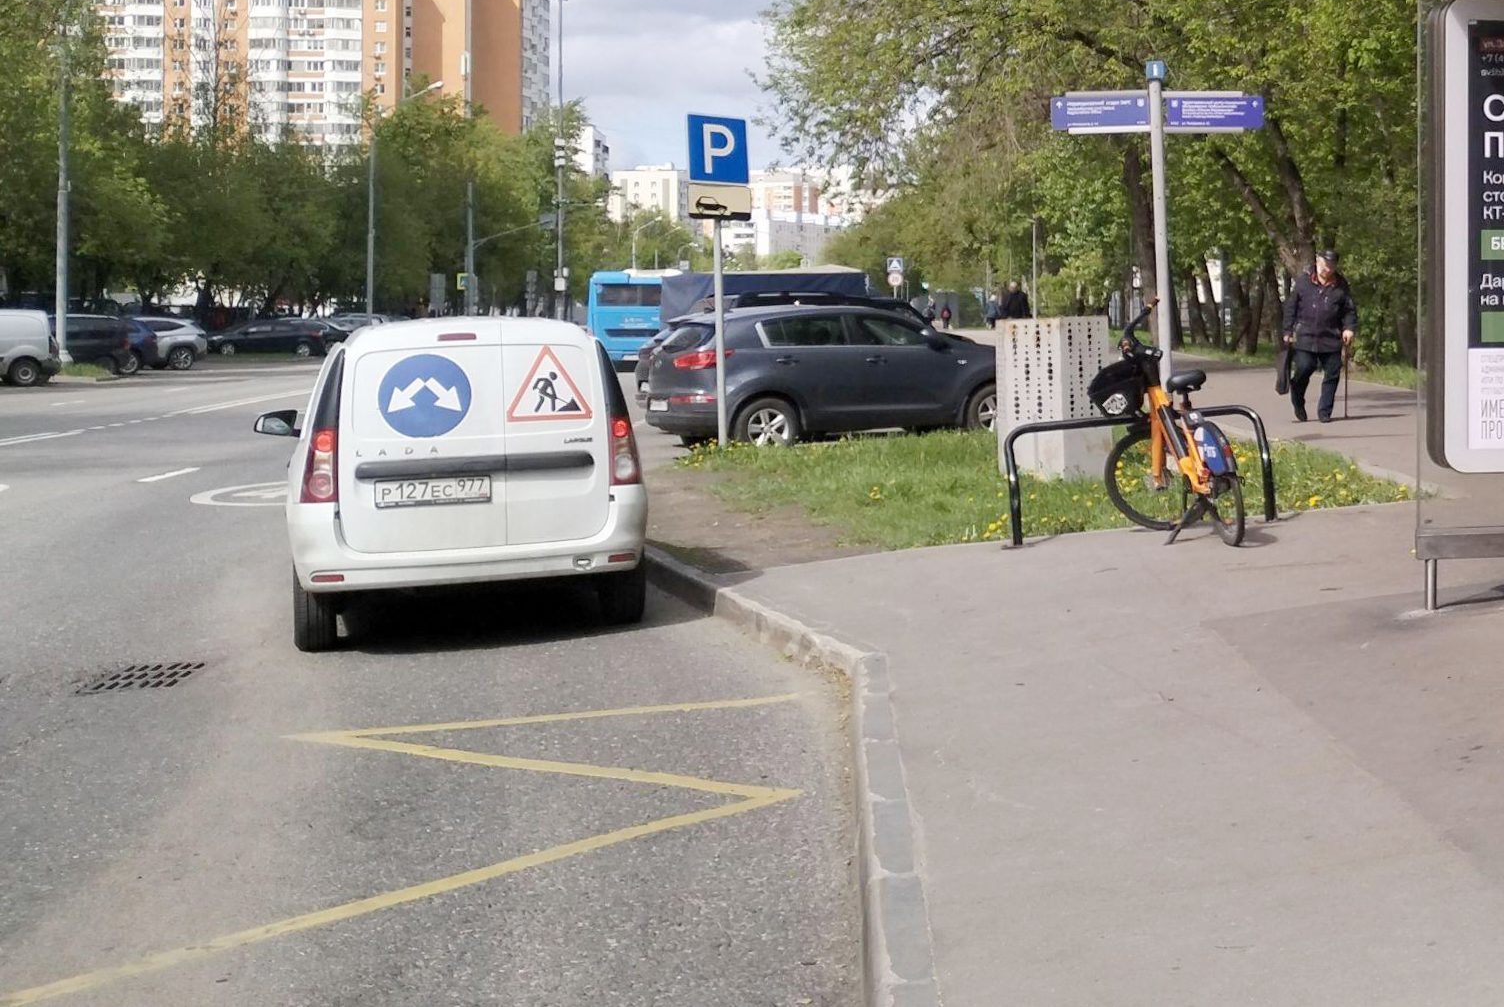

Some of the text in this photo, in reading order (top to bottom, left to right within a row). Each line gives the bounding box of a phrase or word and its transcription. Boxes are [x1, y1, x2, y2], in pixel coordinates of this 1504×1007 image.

[702, 123, 735, 174] P
[1480, 296, 1499, 306] на
[356, 446, 438, 457] LADA
